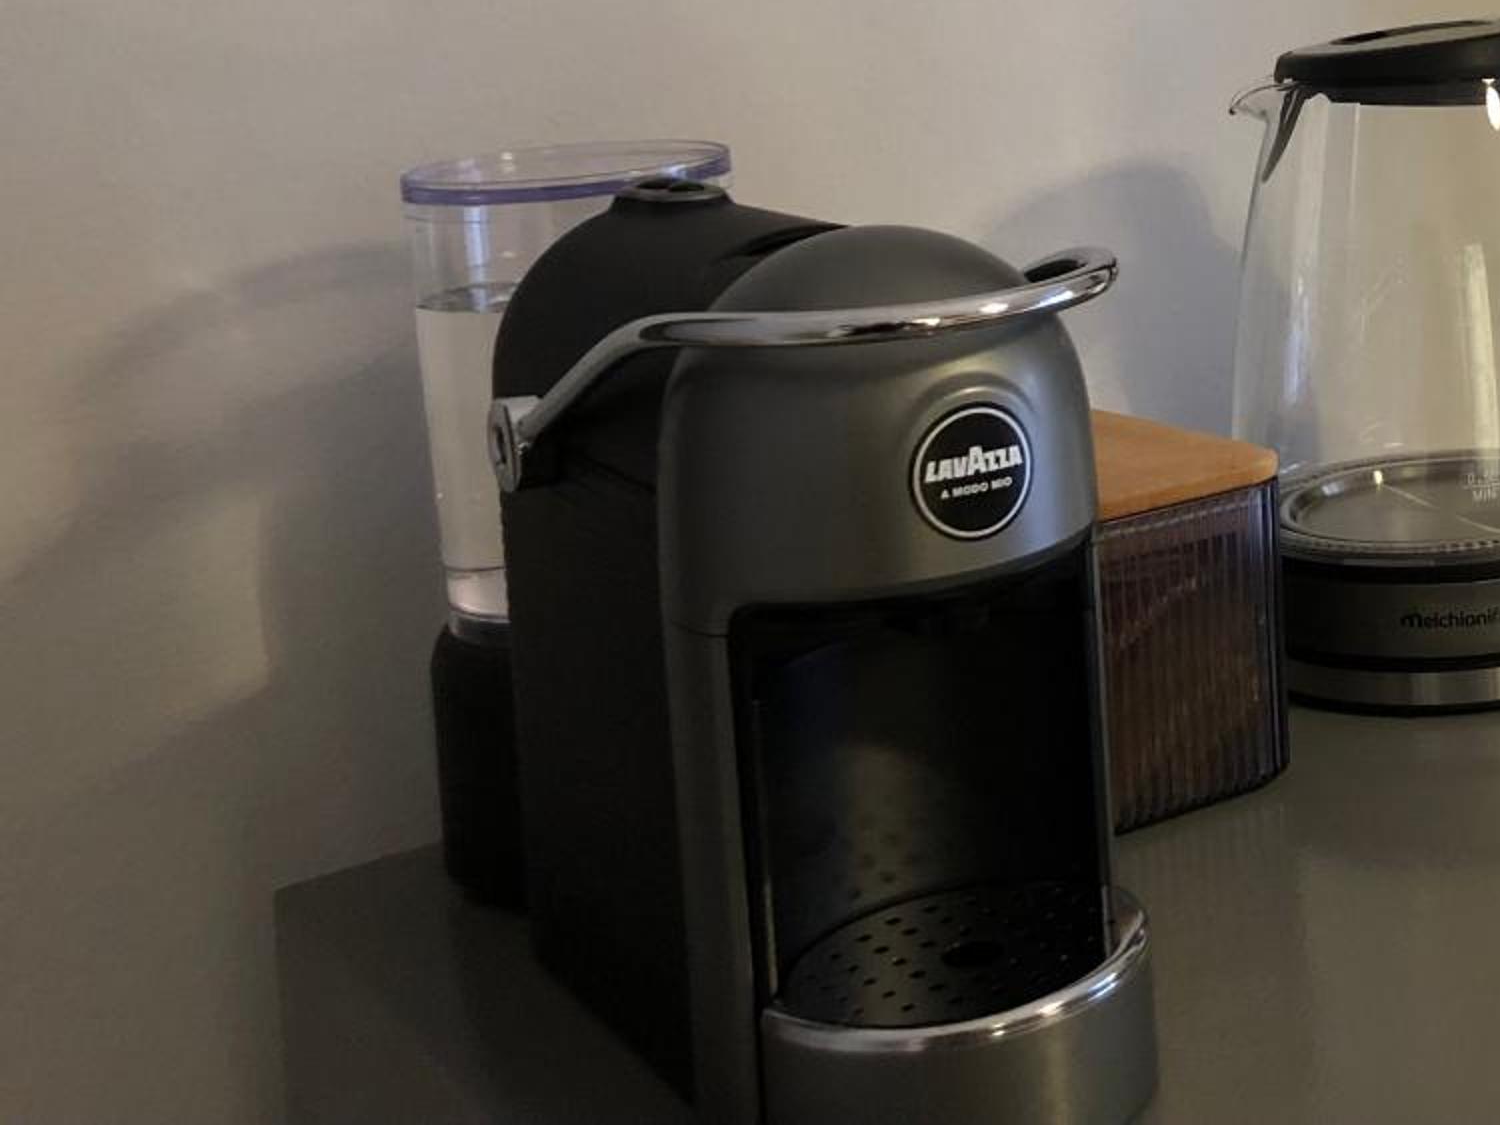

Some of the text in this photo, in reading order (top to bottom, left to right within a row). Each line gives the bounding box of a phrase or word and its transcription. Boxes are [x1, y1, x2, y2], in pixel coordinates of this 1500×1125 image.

[924, 445, 1023, 483] LAVAZZA
[940, 476, 1013, 500] A MODO MIO
